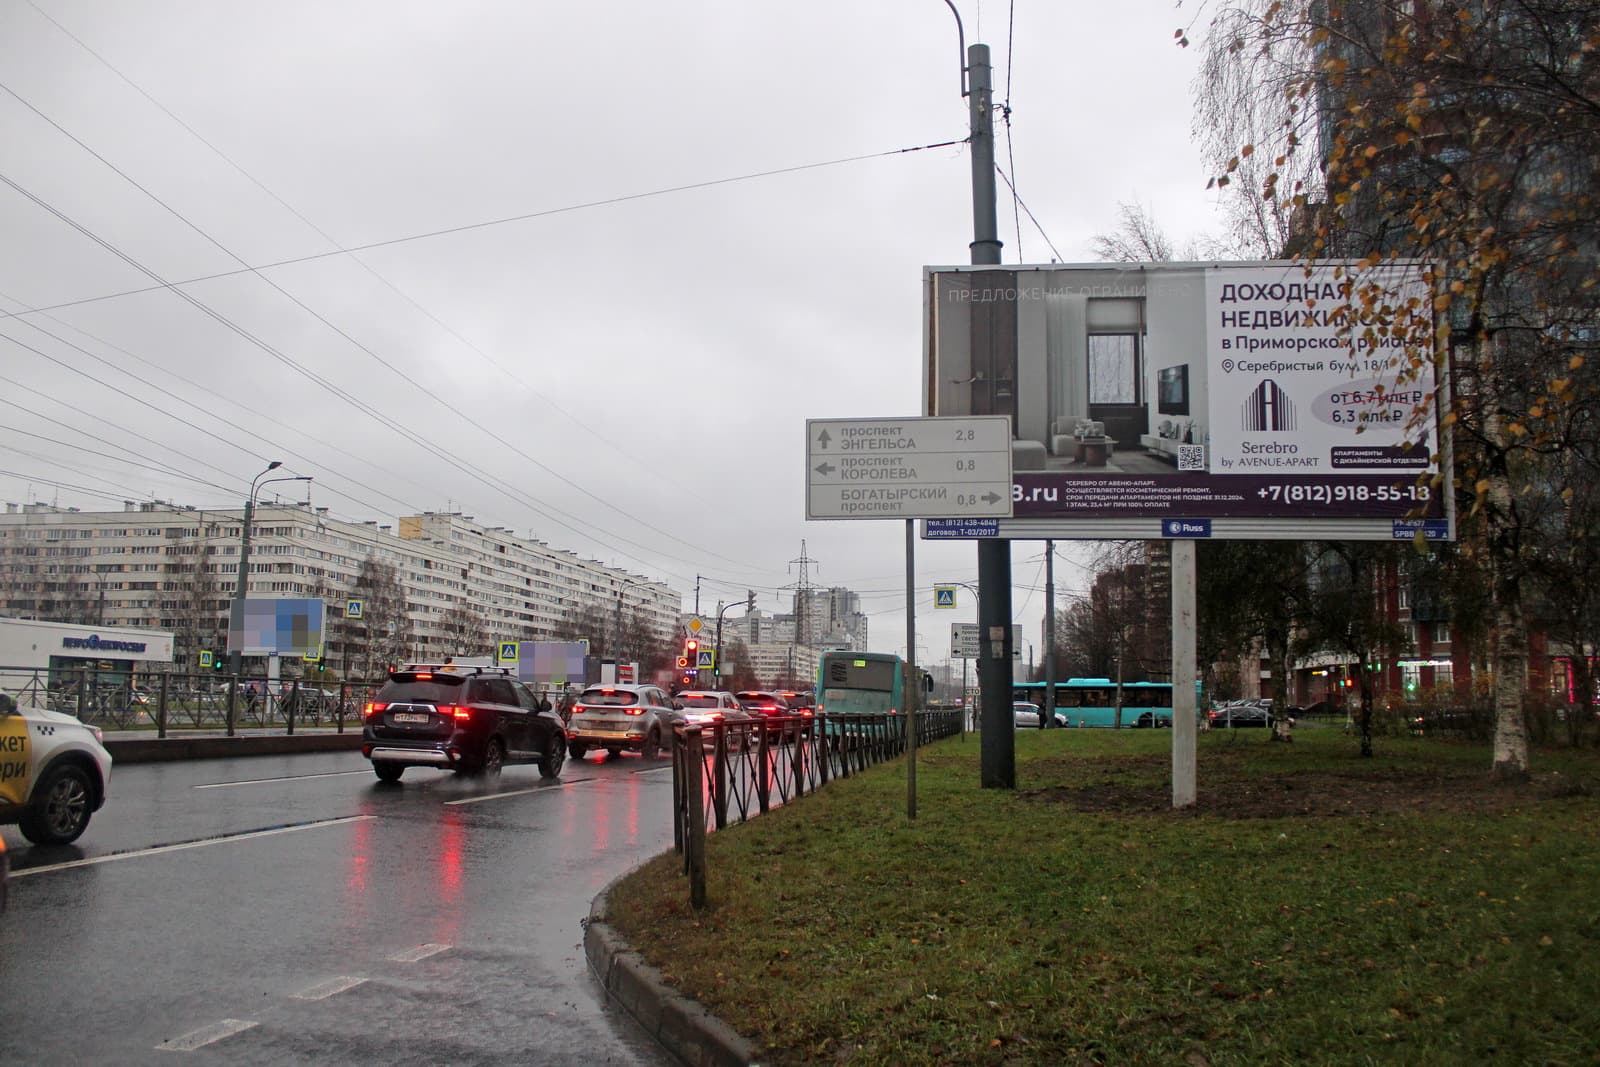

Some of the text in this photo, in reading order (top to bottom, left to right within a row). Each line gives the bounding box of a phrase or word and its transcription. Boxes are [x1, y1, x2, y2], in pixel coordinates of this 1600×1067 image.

[1221, 338, 1231, 349] в
[1237, 359, 1323, 373] Серебристый
[1331, 393, 1348, 404] от
[1332, 410, 1355, 424] 6,3
[841, 426, 975, 441] проспект 2,8
[841, 438, 916, 450] ЭНГЕЛЬСА
[1241, 441, 1298, 454] Serebro
[841, 456, 976, 472] проспект 0,8
[1221, 457, 1320, 468] by AVENUE-APART
[841, 468, 918, 480] КОРОЛЕВА
[841, 486, 976, 507] БОГАТЫРСКИЙ 0,8
[841, 501, 903, 513] проспект
[1182, 524, 1204, 532] Russ
